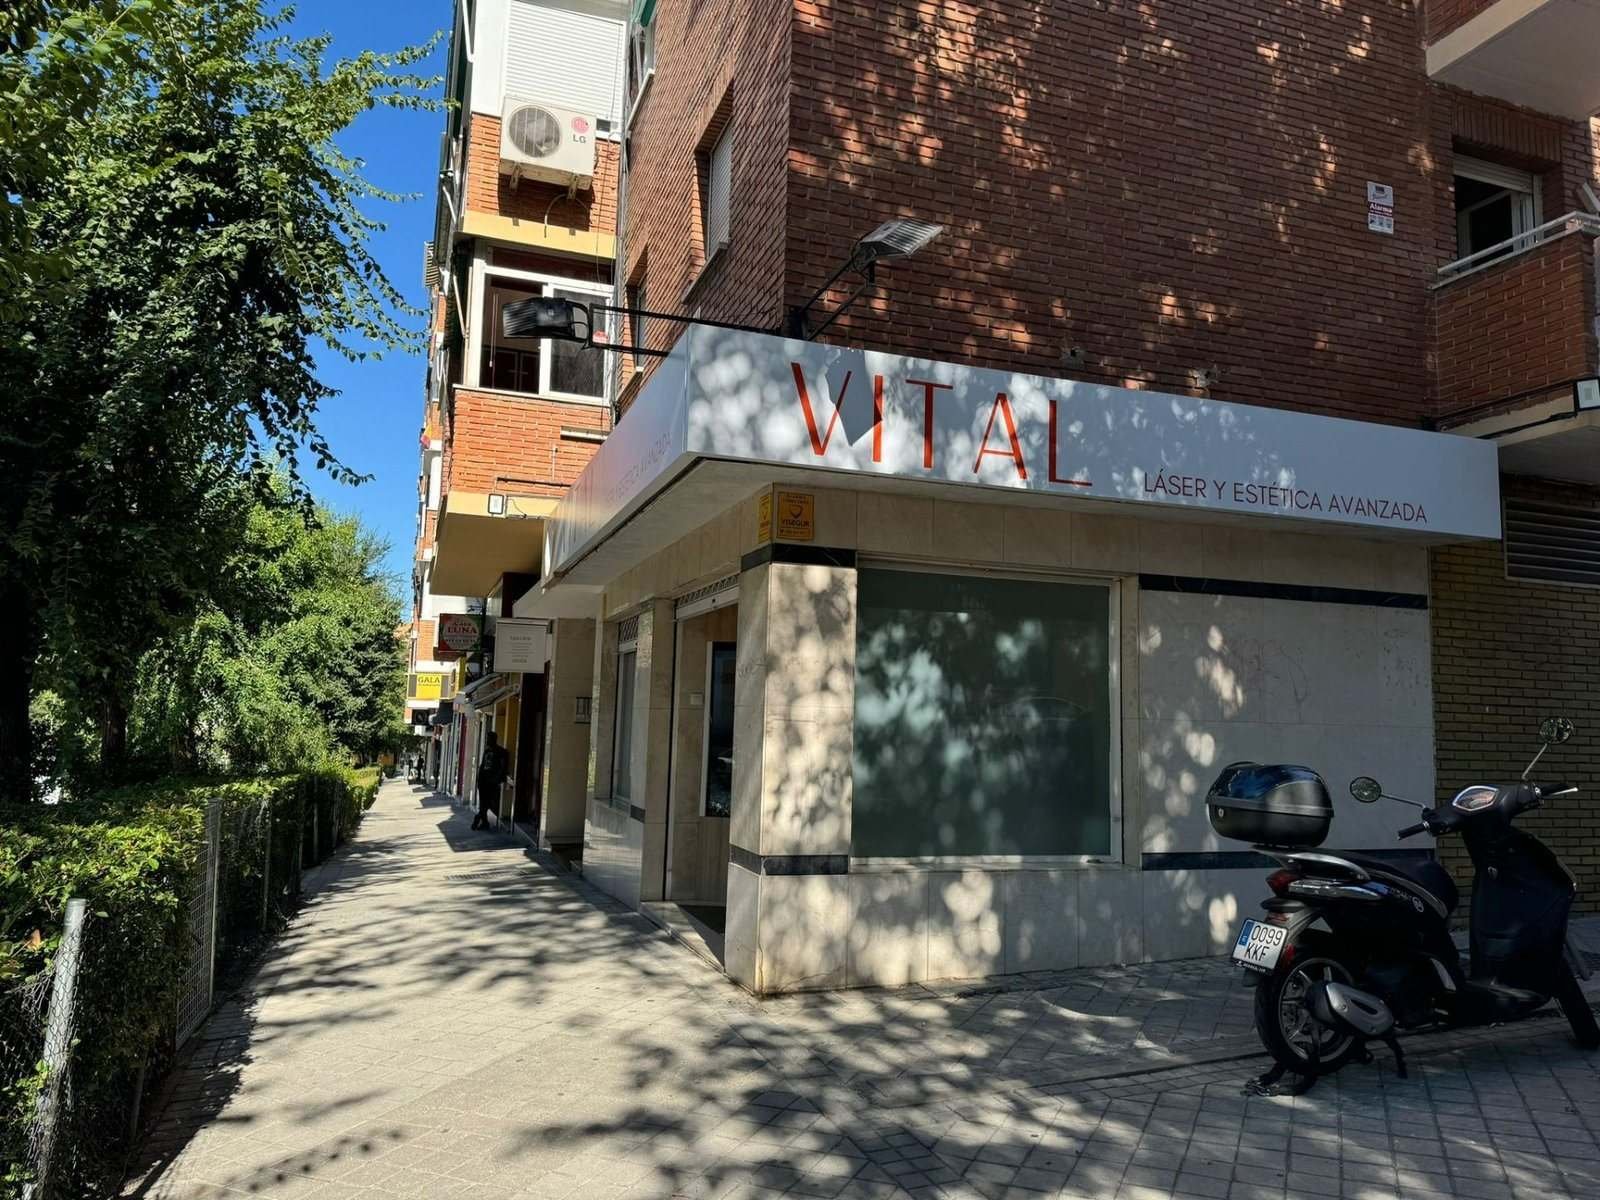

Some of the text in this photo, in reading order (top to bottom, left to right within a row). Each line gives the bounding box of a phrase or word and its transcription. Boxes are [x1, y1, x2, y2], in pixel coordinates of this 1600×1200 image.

[573, 134, 586, 144] LG
[791, 362, 1093, 486] VITAL
[1144, 468, 1428, 523] LÁSER Y ESTÉTICA AVANZADA
[1251, 925, 1283, 946] 0099
[1244, 942, 1270, 961] KKF
